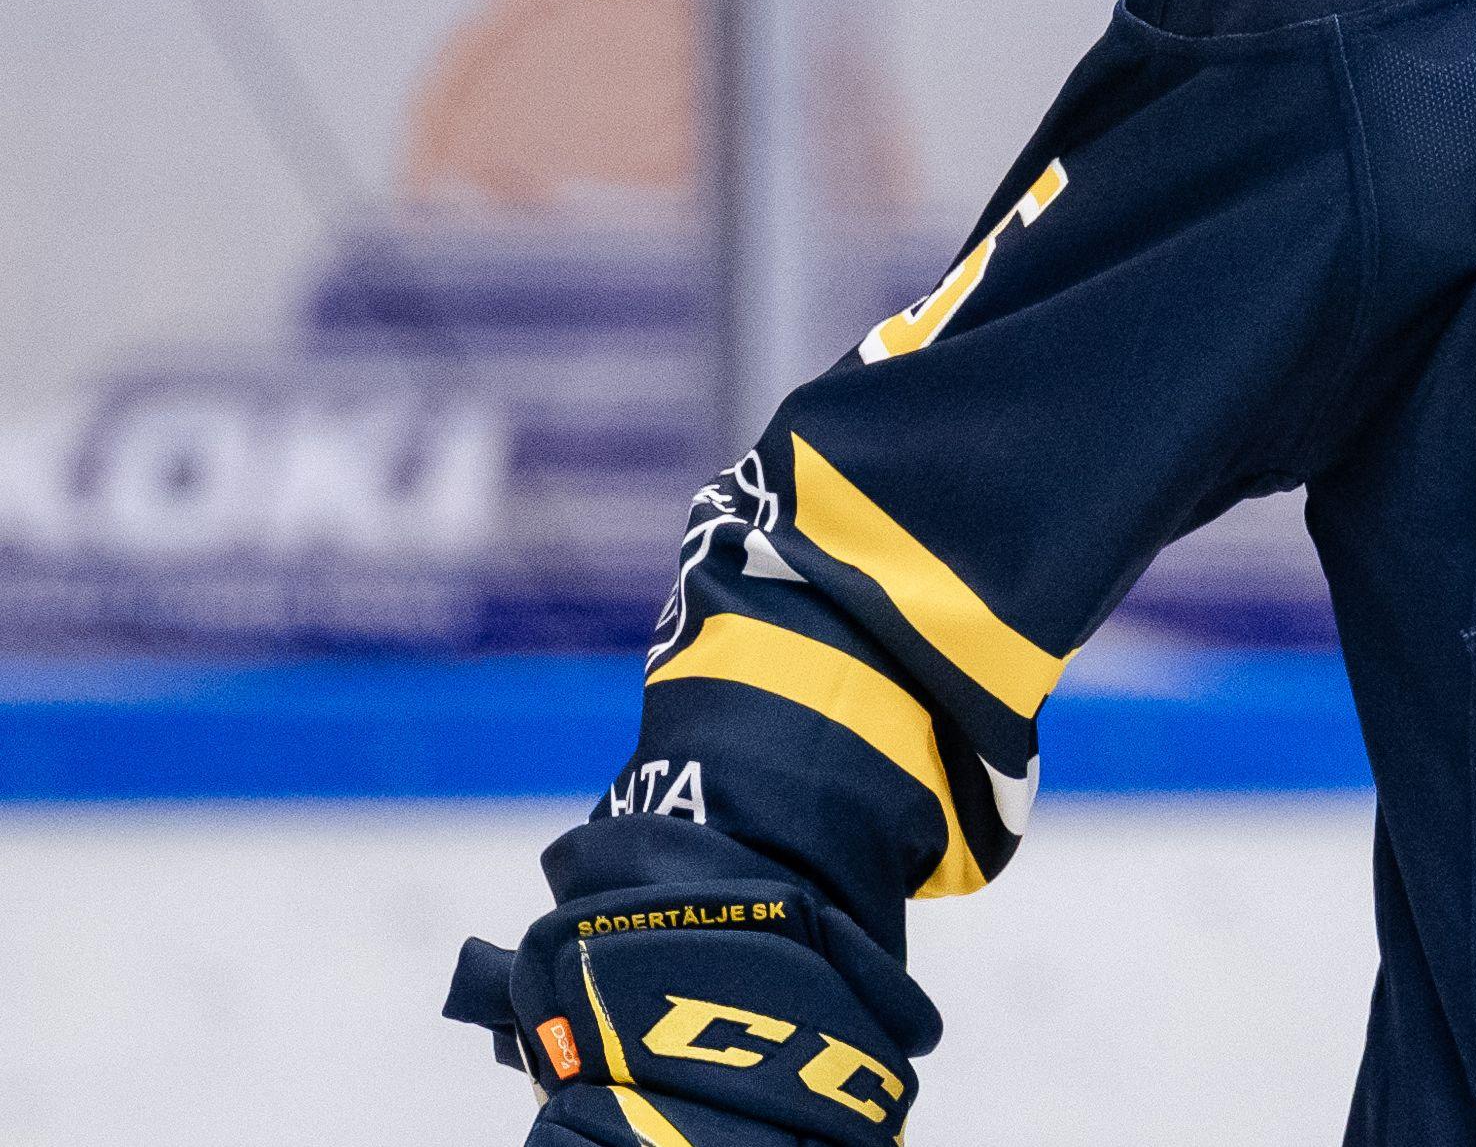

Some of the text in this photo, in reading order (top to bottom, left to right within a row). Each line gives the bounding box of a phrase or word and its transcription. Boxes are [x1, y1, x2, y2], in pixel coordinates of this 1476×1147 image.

[577, 900, 787, 938] SÖDERTÄLJE SK
[641, 995, 905, 1127] CC
